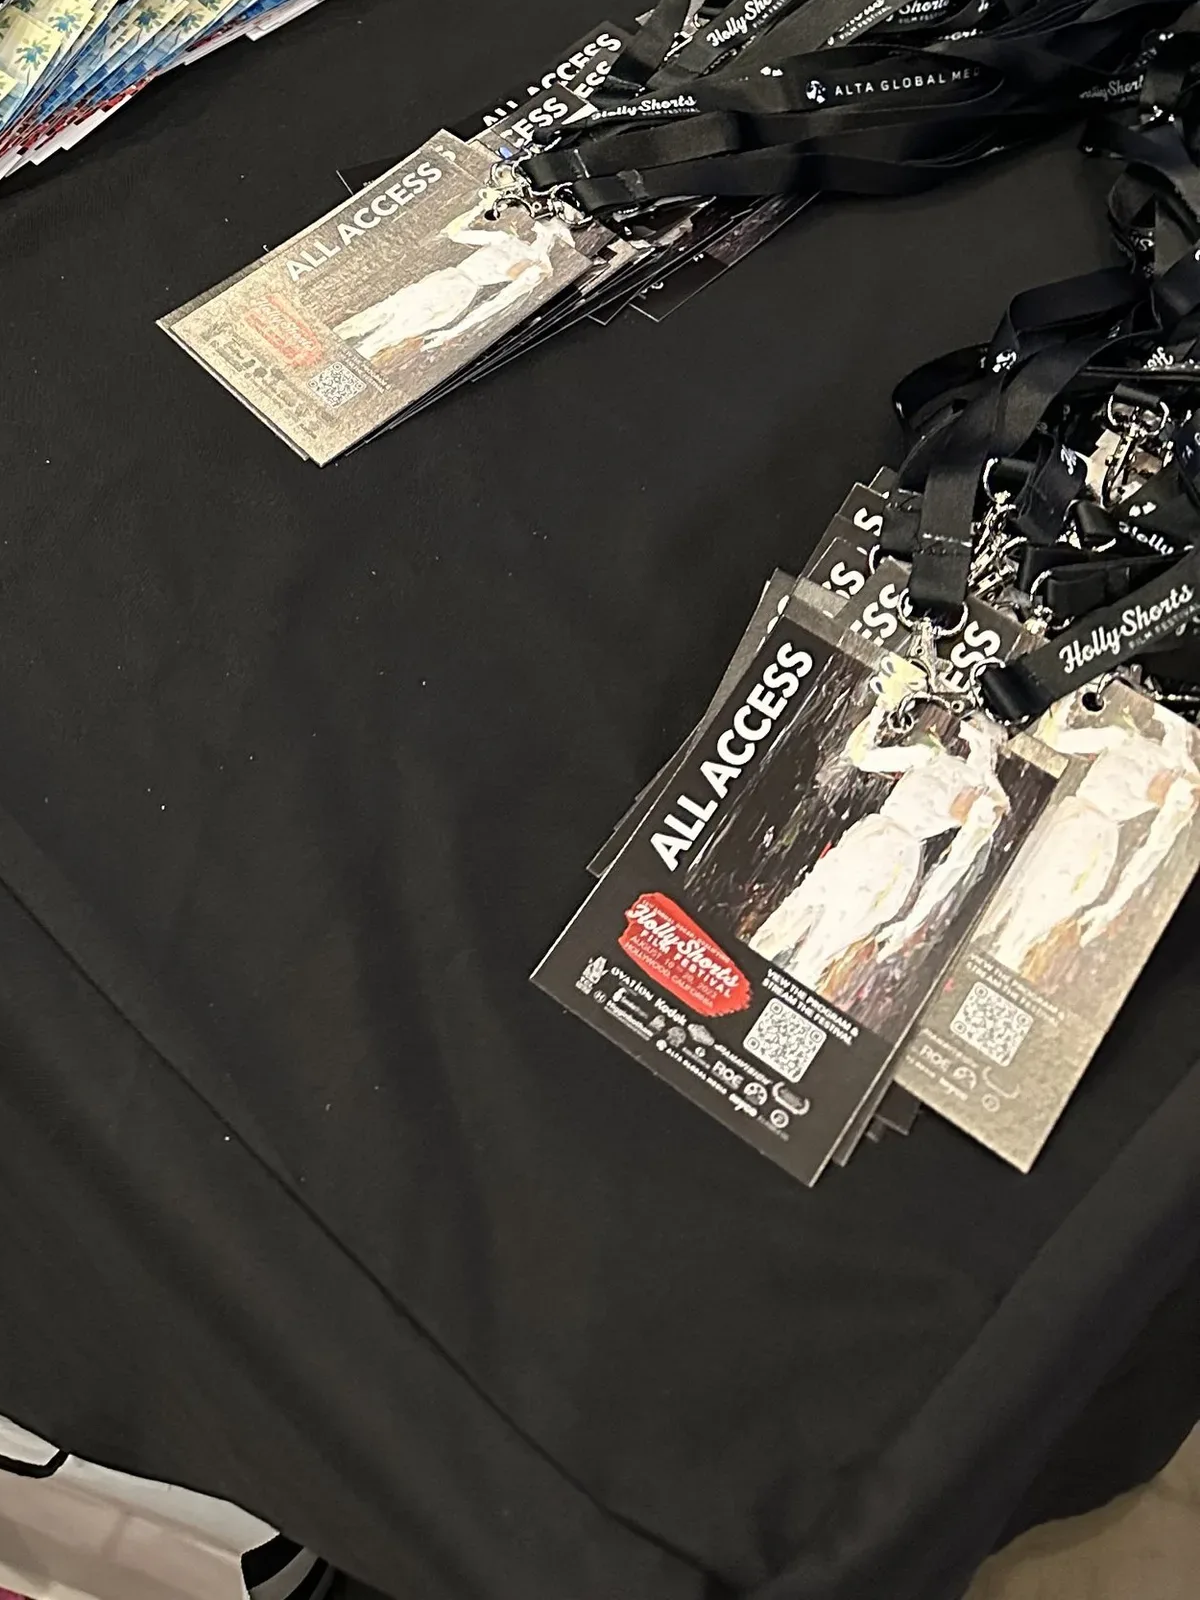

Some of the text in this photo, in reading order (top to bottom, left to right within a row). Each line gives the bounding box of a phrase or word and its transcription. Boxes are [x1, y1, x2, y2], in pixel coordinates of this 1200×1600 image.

[752, 16, 767, 29] FILM
[839, 26, 858, 41] FILM
[858, 4, 892, 29] FESTIVAL
[591, 95, 697, 120] HollyShorts
[835, 66, 980, 97] ALTA GLOBAL MED
[285, 161, 443, 282] ALL ACCESS
[1059, 584, 1194, 674] HollyShorts
[650, 642, 814, 872] ALL ACCESS
[626, 903, 740, 988] HollyShorts
[629, 934, 662, 960] AUGUST
[639, 929, 732, 997] FILM FESTIVAL
[611, 966, 653, 1001] OVATION
[654, 997, 688, 1026] Kodak
[670, 974, 714, 1008] CALIFORNIA
[762, 978, 854, 1046] STREAM THE FESTIVAL
[766, 968, 859, 1037] VIEW THE PROGRAM &
